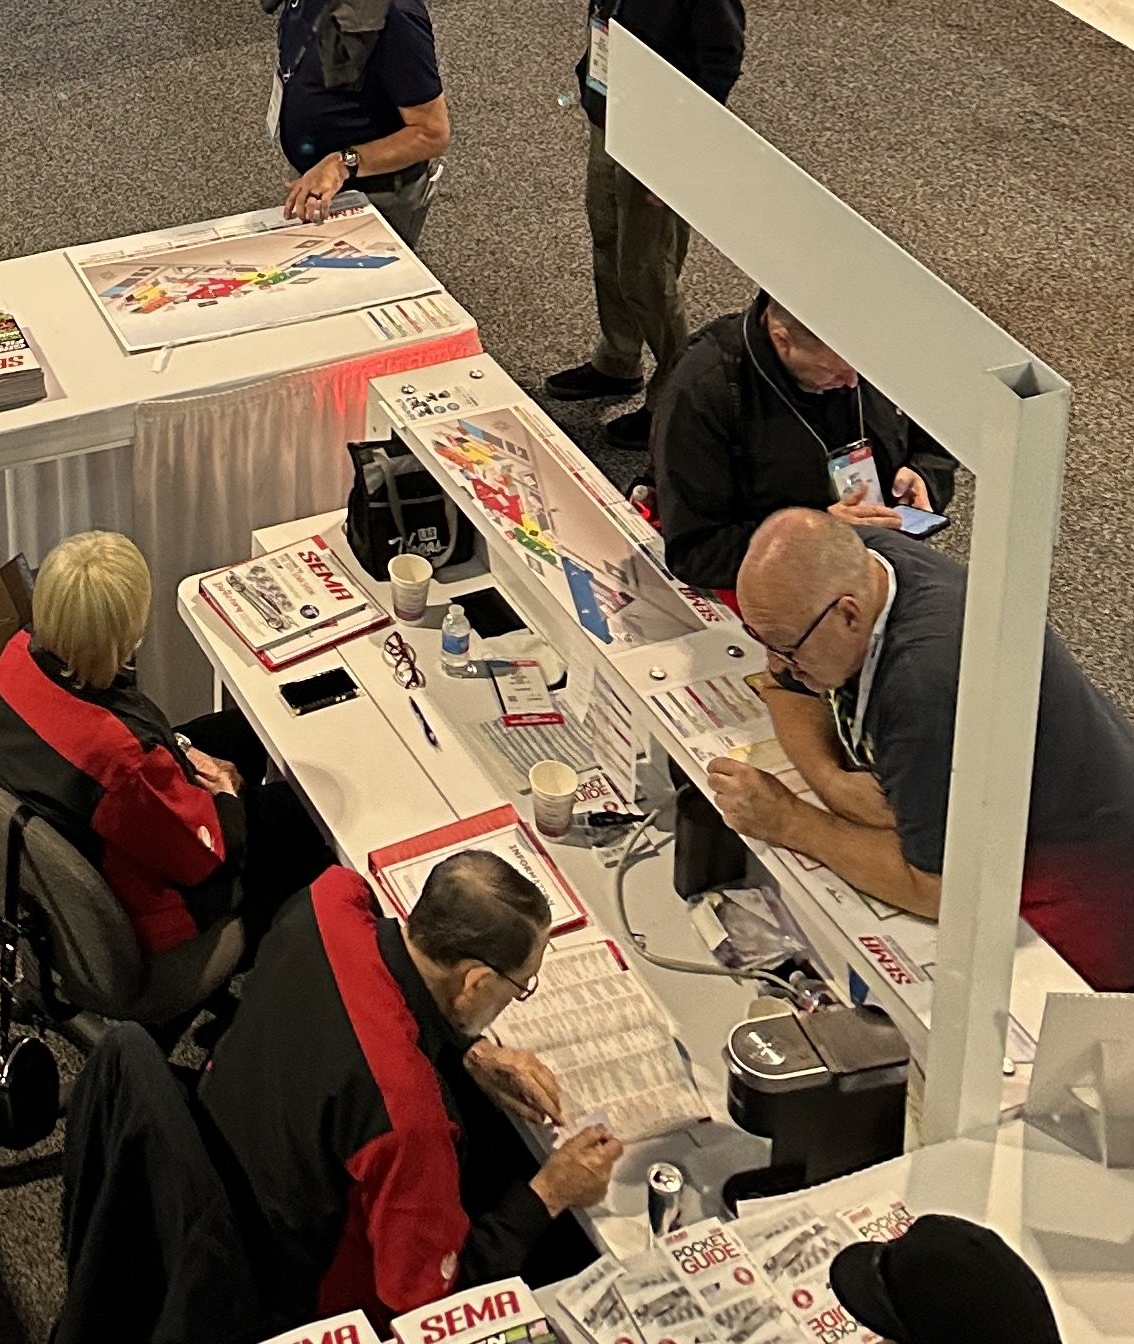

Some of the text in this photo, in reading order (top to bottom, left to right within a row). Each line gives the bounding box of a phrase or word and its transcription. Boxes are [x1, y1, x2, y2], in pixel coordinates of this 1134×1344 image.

[297, 550, 355, 601] SEMA
[575, 784, 611, 804] UIDE
[577, 777, 603, 793] CKET
[858, 936, 912, 985] SEMA
[858, 1206, 912, 1238] POCKET
[671, 1231, 730, 1263] POCKET
[680, 1244, 741, 1275] GUIDE
[419, 1290, 522, 1344] SEMA
[807, 1304, 849, 1337] UIDE
[819, 1319, 858, 1344] CKET
